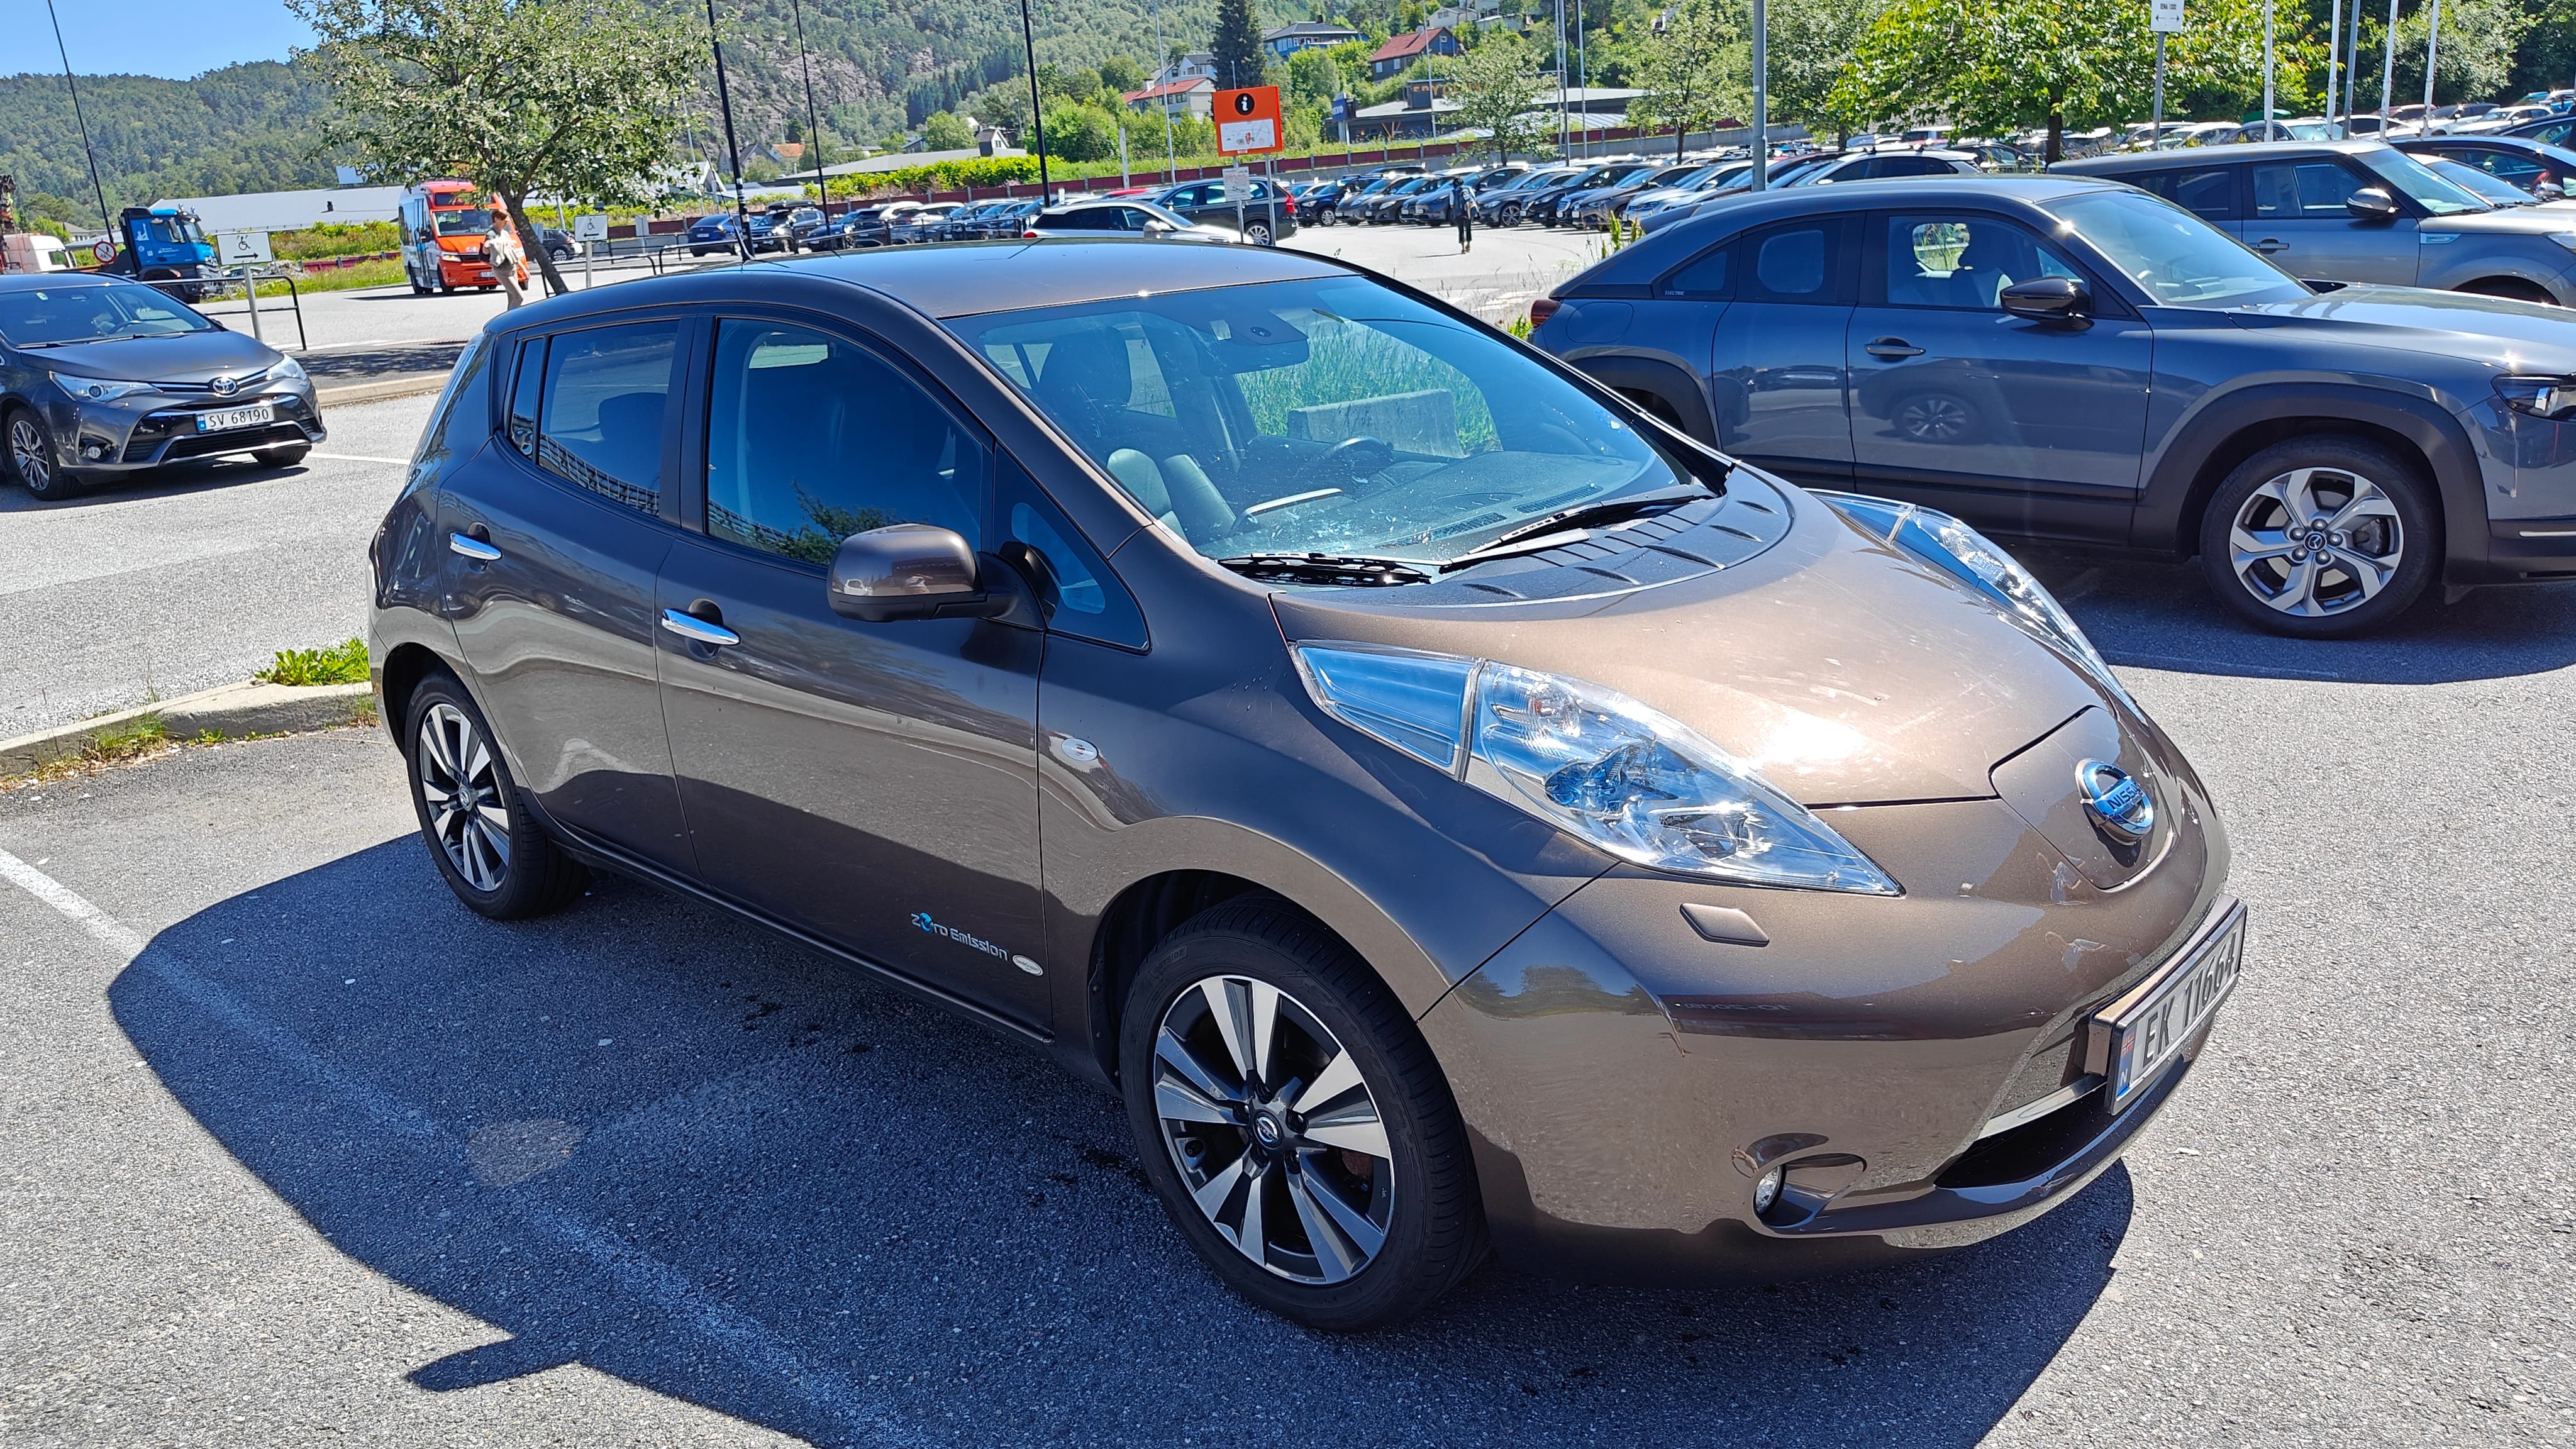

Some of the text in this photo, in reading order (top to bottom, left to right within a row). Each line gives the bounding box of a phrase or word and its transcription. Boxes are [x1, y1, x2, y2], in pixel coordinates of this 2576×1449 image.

[209, 409, 269, 427] SV 68190
[950, 928, 1008, 961] Emission
[2143, 930, 2238, 1069] EK 11664
